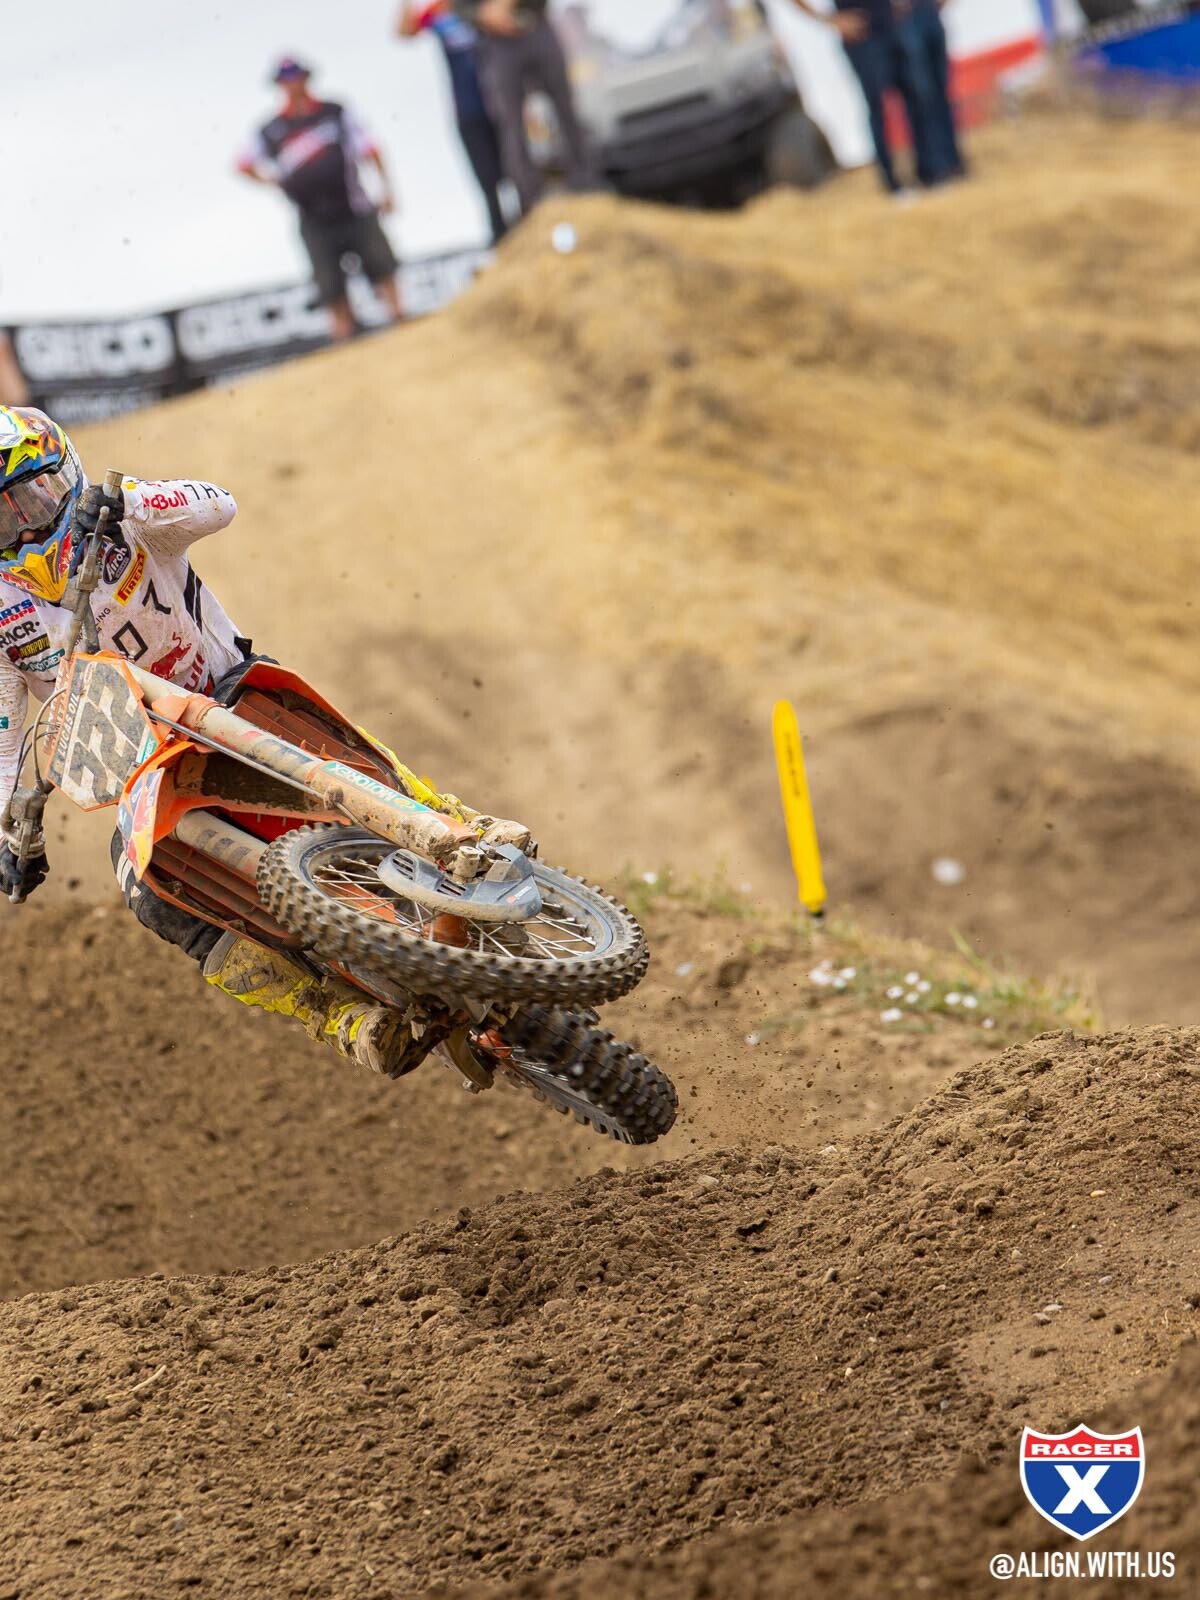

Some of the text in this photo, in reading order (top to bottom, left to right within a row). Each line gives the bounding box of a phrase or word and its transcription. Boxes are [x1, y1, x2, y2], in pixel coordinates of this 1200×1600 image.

[104, 547, 128, 582] Airoh
[58, 693, 80, 758] LUCAS OIL
[69, 663, 146, 803] 222
[329, 763, 396, 802] MOTOREX
